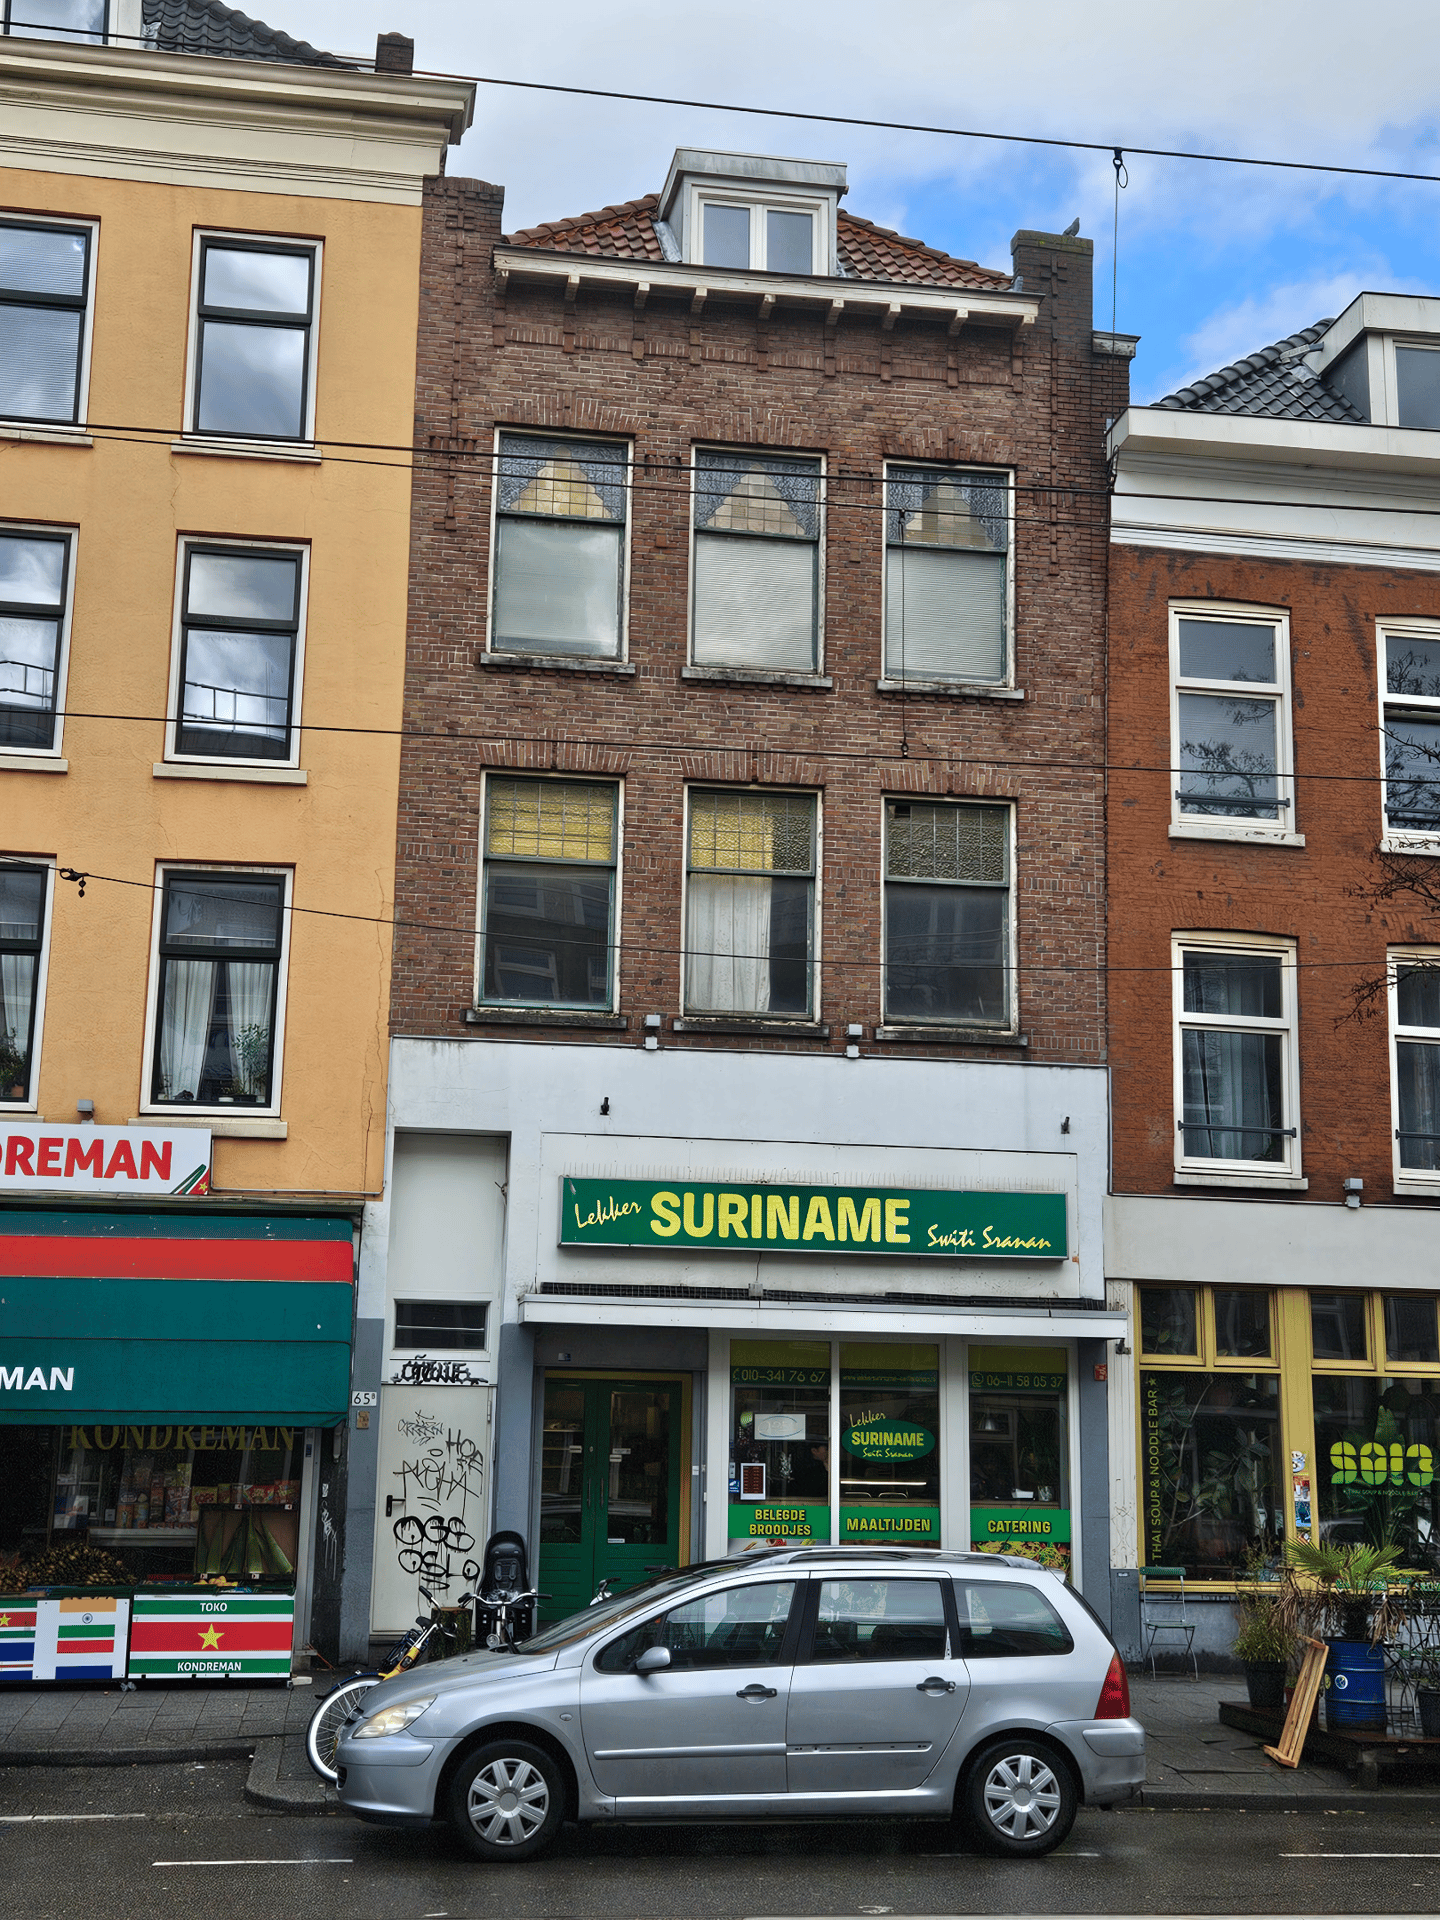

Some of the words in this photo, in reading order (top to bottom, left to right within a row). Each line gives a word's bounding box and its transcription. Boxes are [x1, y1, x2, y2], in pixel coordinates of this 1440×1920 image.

[0, 1135, 172, 1180] REMAN
[575, 1196, 642, 1229] Lekker
[650, 1191, 911, 1244] SURINAME
[927, 1224, 976, 1248] Switi
[982, 1225, 1052, 1250] Sranan
[0, 1366, 75, 1391] MAN
[789, 1370, 806, 1382] 76
[809, 1371, 826, 1383] 67
[1016, 1375, 1030, 1388] 58
[1033, 1375, 1047, 1388] 05
[1050, 1376, 1064, 1388] 37
[1147, 1389, 1158, 1416] BAR
[849, 1409, 886, 1428] Lekker
[67, 1425, 295, 1451] KONDREMAN
[851, 1431, 925, 1447] SURINAME
[1148, 1420, 1160, 1475] NOODLE
[1149, 1479, 1160, 1488] &
[755, 1509, 806, 1521] BELEGDE
[1150, 1490, 1161, 1526] SOUP
[749, 1524, 811, 1536] BROODJES
[846, 1518, 931, 1532] MAALTIJDEN
[987, 1520, 1052, 1534] CATERING
[1152, 1531, 1162, 1561] THAI
[200, 1602, 228, 1612] TOKO
[177, 1661, 242, 1672] KONDREMAN
